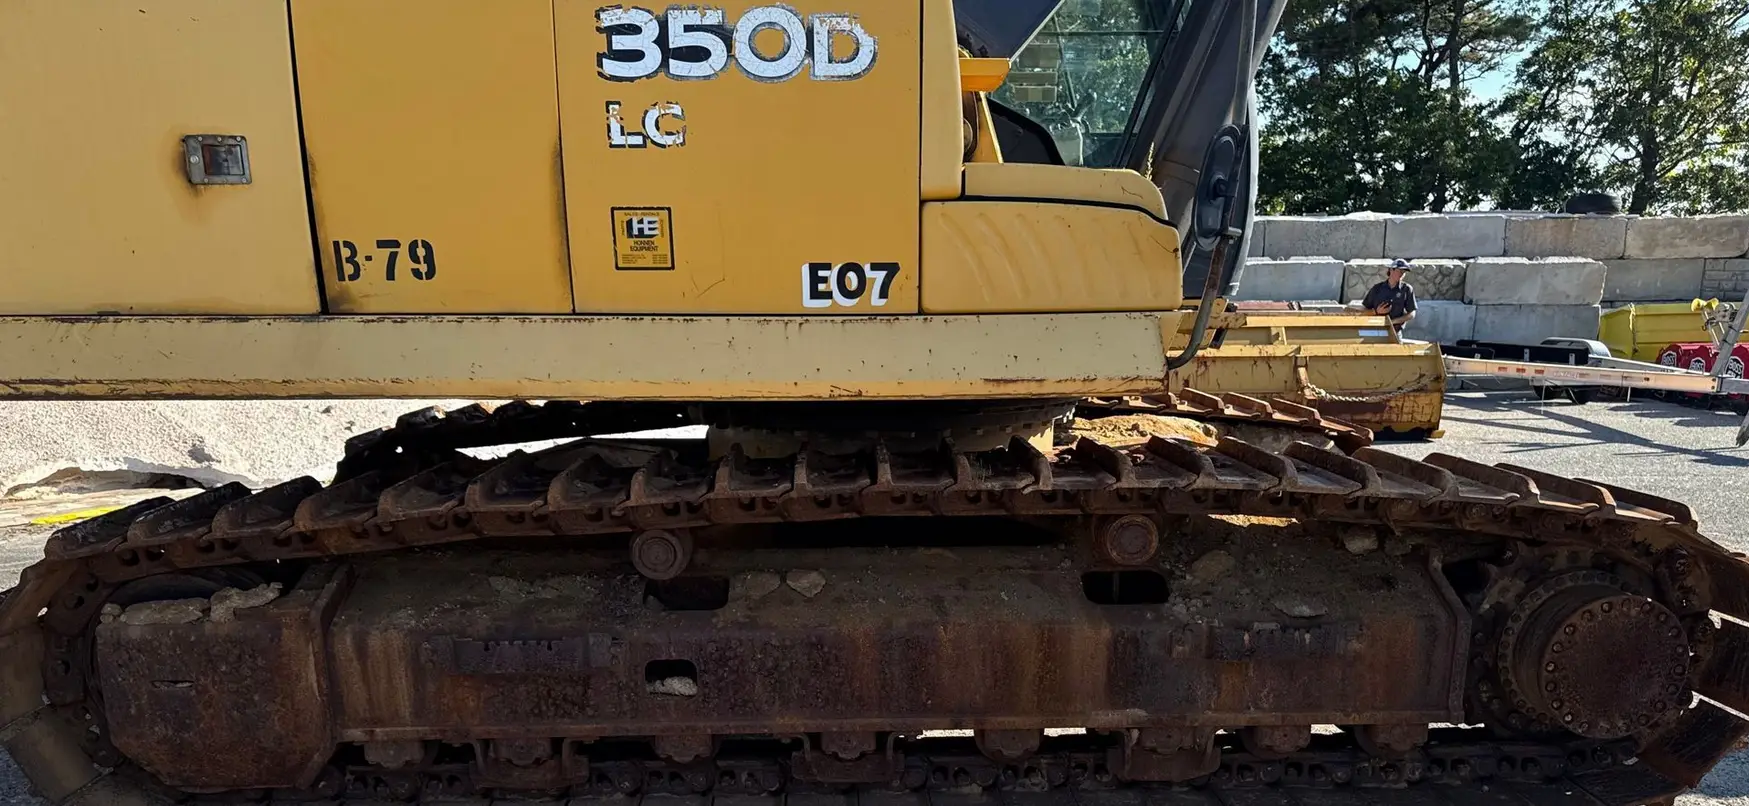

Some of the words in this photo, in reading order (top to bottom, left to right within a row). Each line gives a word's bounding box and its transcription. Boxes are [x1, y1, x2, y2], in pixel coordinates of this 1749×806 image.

[595, 3, 878, 82] 350D
[606, 101, 686, 148] LC
[332, 239, 437, 282] B-79
